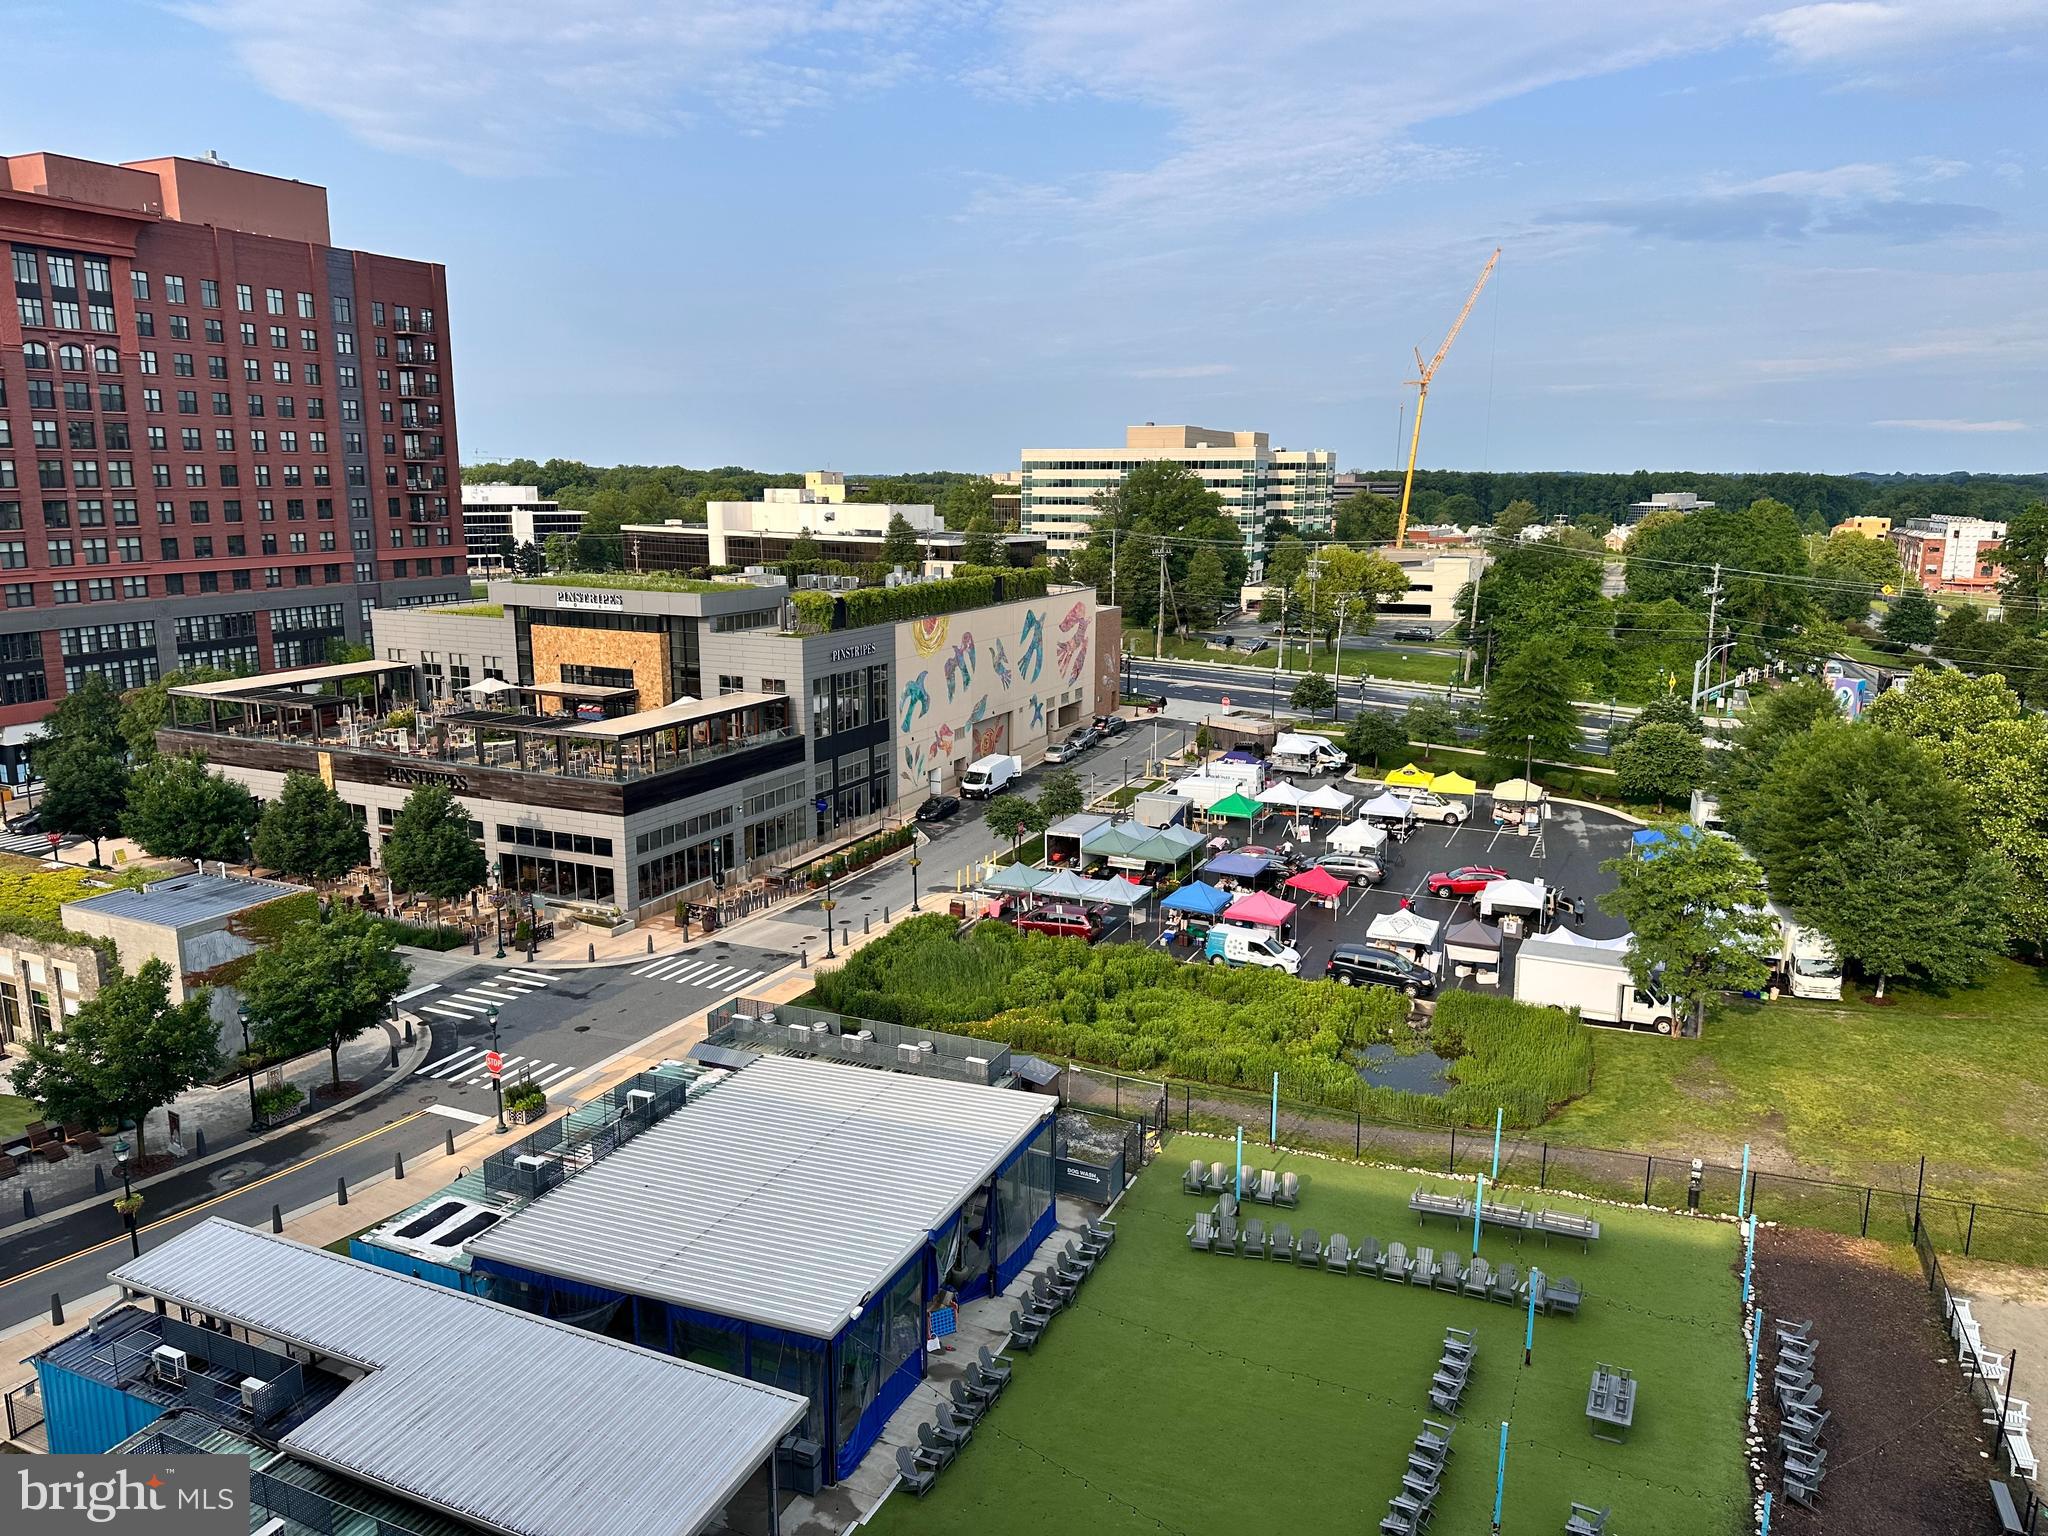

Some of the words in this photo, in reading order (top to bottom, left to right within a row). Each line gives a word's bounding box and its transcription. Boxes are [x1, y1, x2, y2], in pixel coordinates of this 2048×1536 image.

[557, 591, 623, 605] PINSTRIPES
[832, 643, 876, 661] PINSTRIPES
[386, 766, 468, 791] PINSTRIPES
[487, 1057, 502, 1067] STOP
[1067, 1167, 1079, 1175] DOG
[1080, 1170, 1097, 1179] WASH
